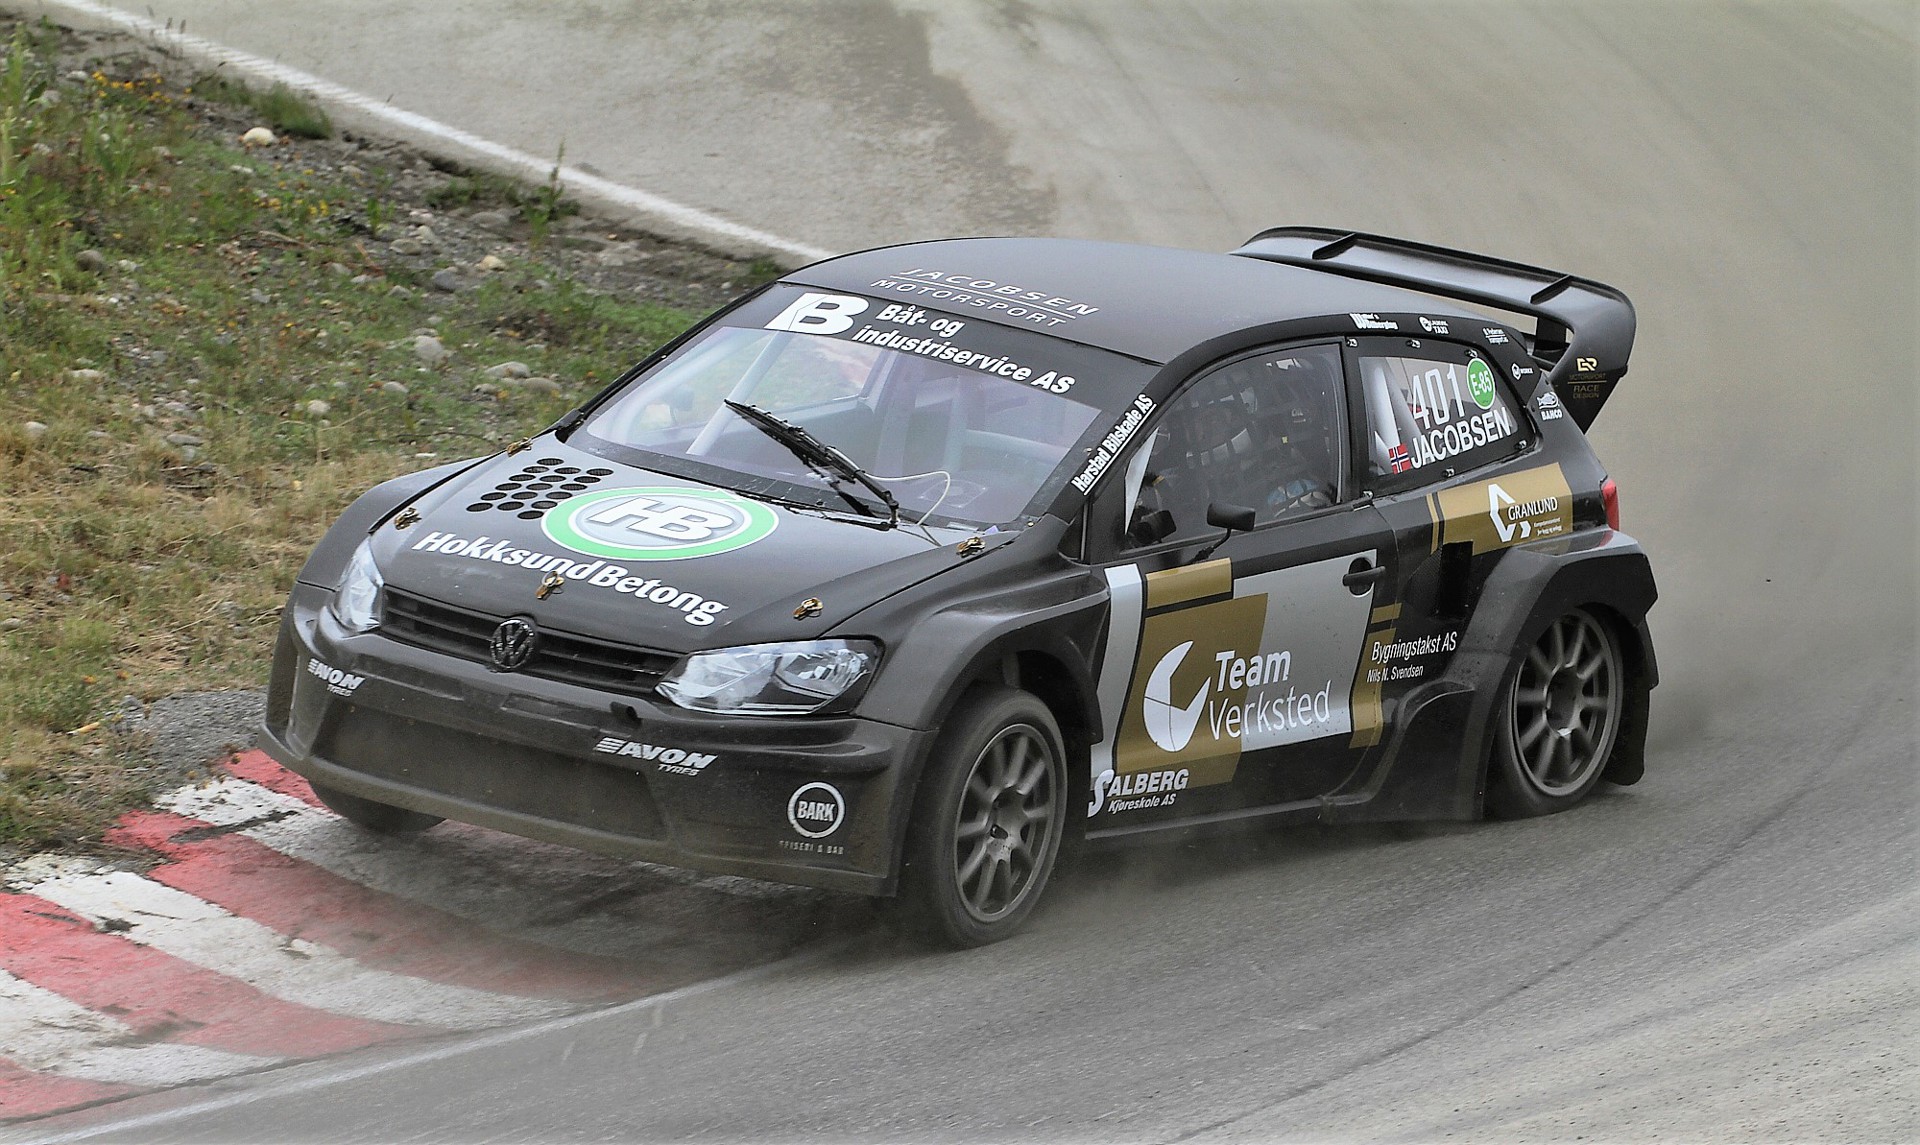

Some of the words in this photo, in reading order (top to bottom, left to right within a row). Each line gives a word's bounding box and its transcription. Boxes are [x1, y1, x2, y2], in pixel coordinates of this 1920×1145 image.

[870, 279, 1067, 327] MOTORSPORT
[900, 268, 1099, 316] JACOBSEN
[875, 303, 928, 326] Båt-
[929, 317, 966, 338] og
[852, 325, 1032, 381] industriservice
[1031, 370, 1076, 394] AS
[1412, 363, 1465, 430] 401
[1470, 370, 1493, 396] E-85
[1573, 384, 1600, 392] RACE
[1540, 408, 1563, 421] BAHCO
[1071, 446, 1112, 492] Harstad
[1101, 409, 1143, 454] Bilskade
[1133, 393, 1153, 414] AS
[1411, 406, 1512, 469] JACOBSEN
[586, 497, 734, 541] HB
[1508, 496, 1558, 521] GRANLUND
[1371, 634, 1441, 665] Bygningstakst
[1440, 631, 1458, 652] AS
[314, 662, 366, 690] AVON
[1215, 650, 1291, 692] Team
[1366, 668, 1381, 683] Nils
[1381, 667, 1389, 681] N.
[1391, 664, 1424, 680] Svendsen
[1209, 679, 1332, 741] Verksted
[616, 741, 719, 769] AVON
[657, 763, 700, 776] TYRES
[1087, 768, 1189, 818] SALBERG
[1107, 795, 1160, 814] Kjøreskole
[1160, 793, 1177, 806] AS
[797, 800, 836, 822] BARK
